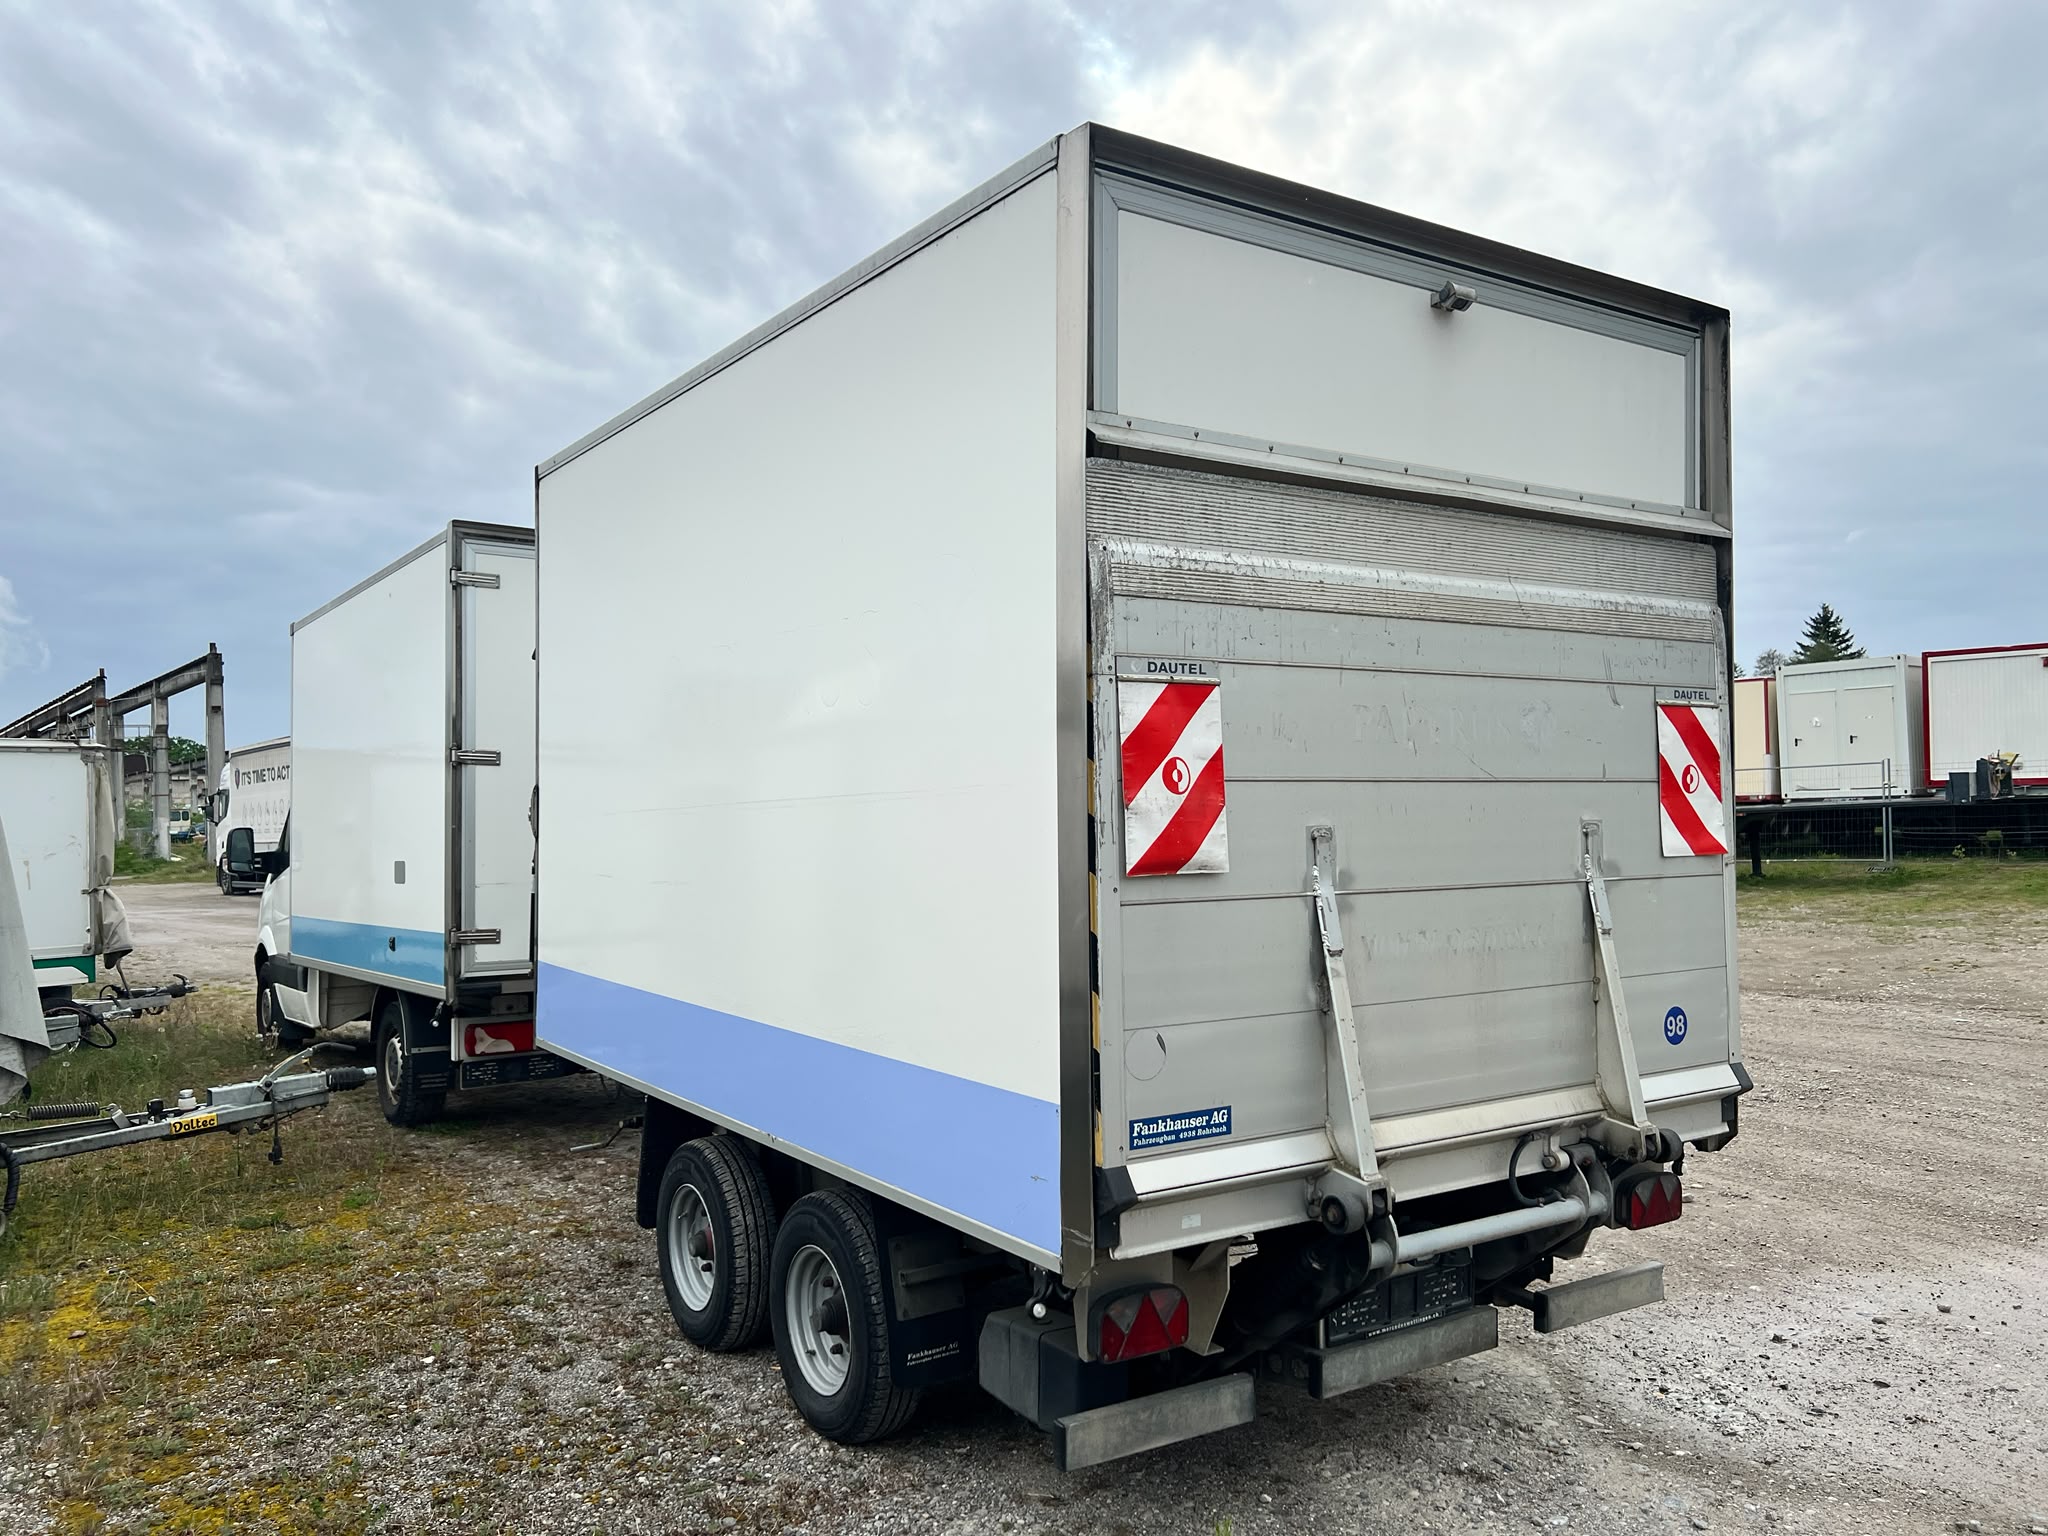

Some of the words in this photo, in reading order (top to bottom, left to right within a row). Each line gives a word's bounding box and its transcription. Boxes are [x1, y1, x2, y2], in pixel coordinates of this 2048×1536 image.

[1147, 661, 1207, 675] DAUTEL
[1673, 689, 1710, 700] DAUTEL
[252, 768, 267, 785] TIME
[266, 766, 276, 782] TO
[276, 764, 291, 780] ACT
[1666, 1014, 1685, 1037] 98
[1132, 1115, 1209, 1137] Fankhauser
[1210, 1109, 1228, 1124] AG
[1133, 1134, 1176, 1147] Fahrzeugbau
[1197, 1125, 1227, 1136] Rohrbach
[907, 1346, 947, 1361] Fankhauser
